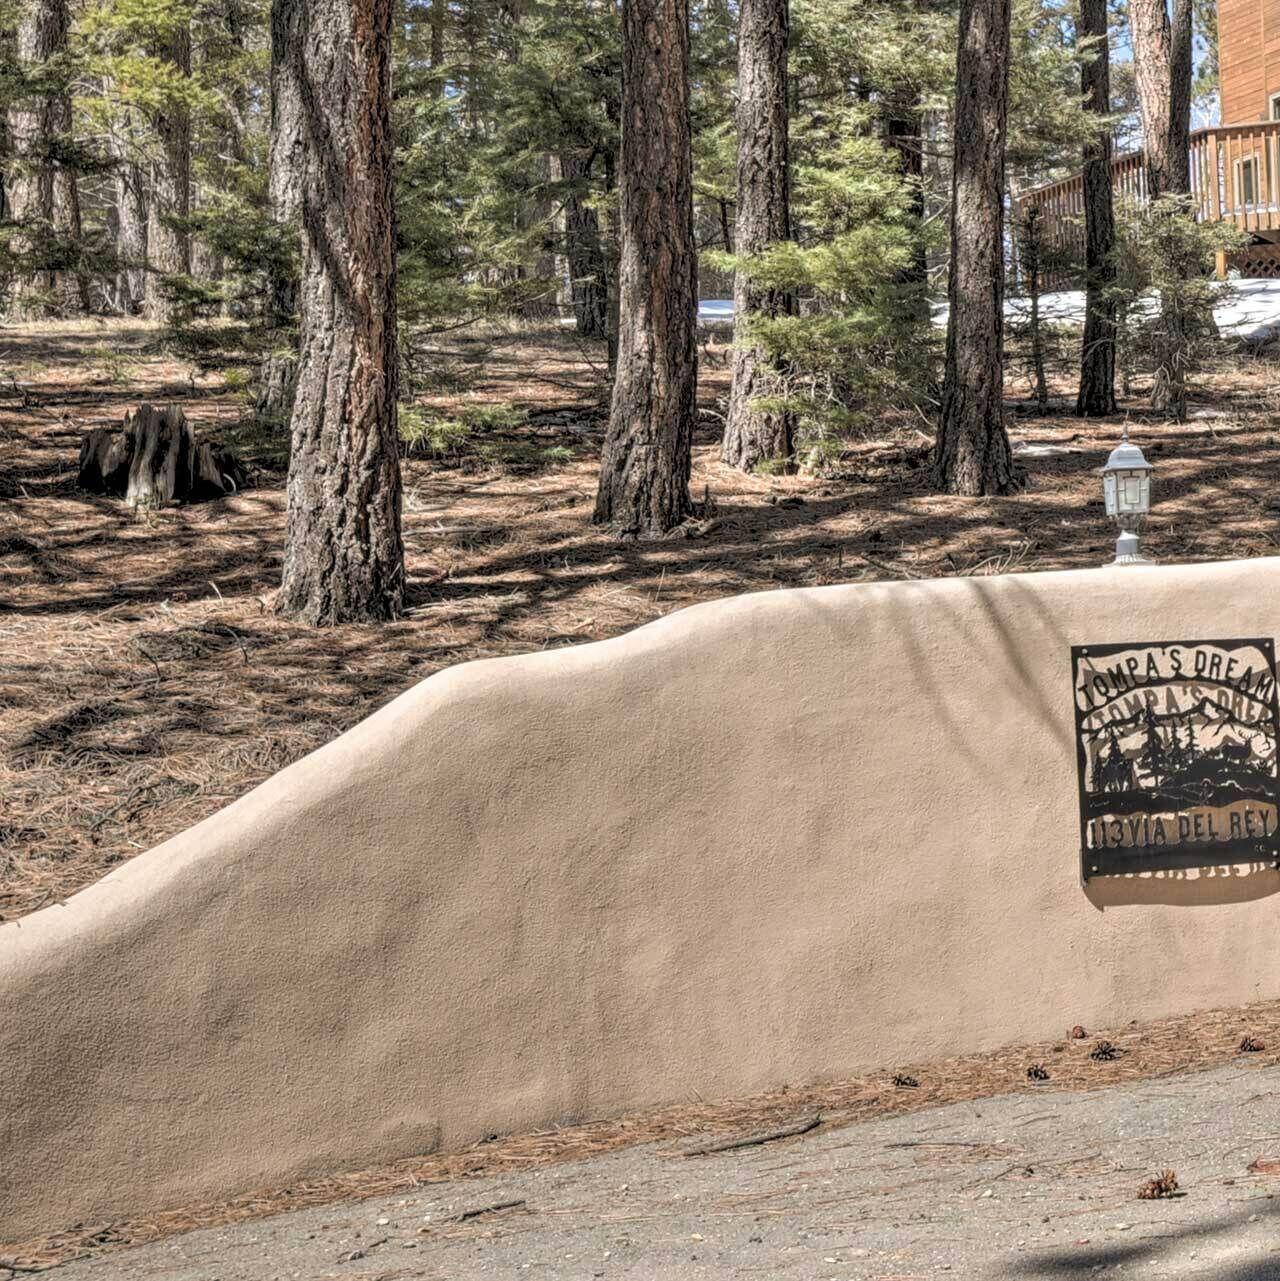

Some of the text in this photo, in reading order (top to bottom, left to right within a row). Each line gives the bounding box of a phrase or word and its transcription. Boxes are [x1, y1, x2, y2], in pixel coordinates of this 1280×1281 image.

[1078, 649, 1276, 708] TOMPA'S DREAM
[1128, 817, 1168, 847] VIA
[1178, 814, 1218, 841] DEL
[1229, 809, 1271, 839] REY
